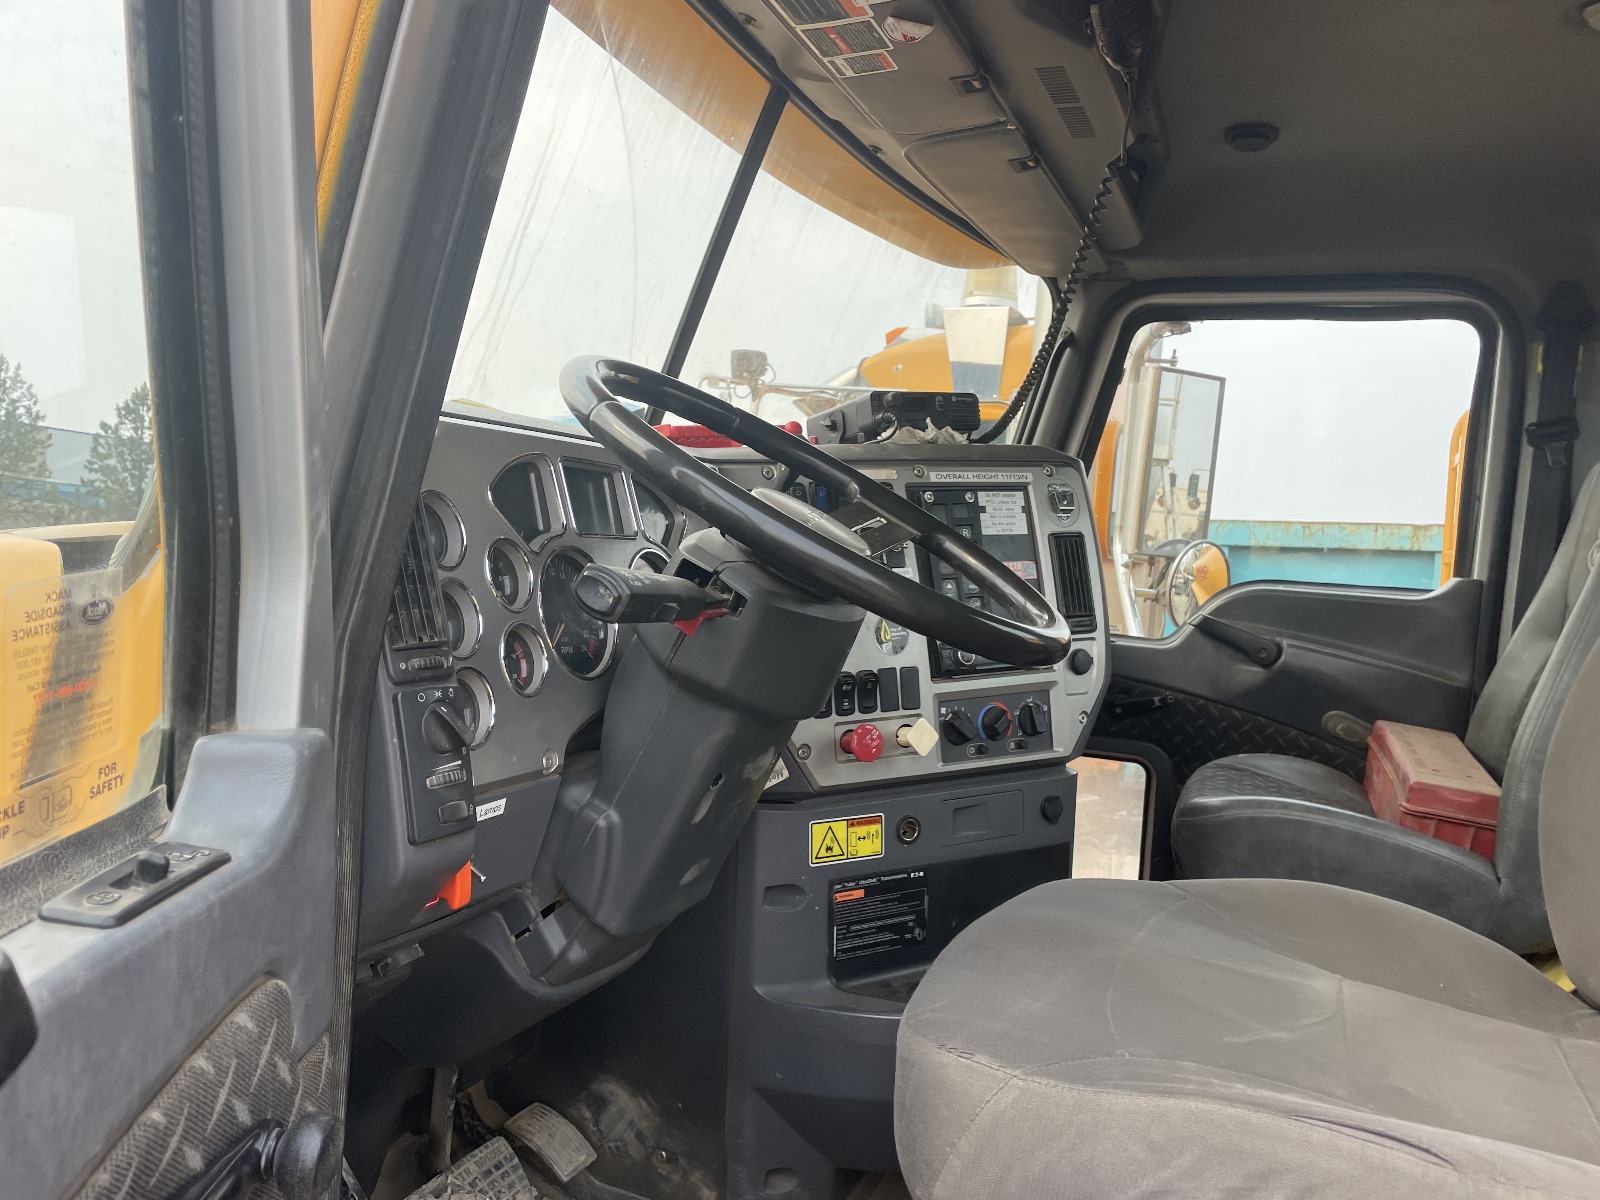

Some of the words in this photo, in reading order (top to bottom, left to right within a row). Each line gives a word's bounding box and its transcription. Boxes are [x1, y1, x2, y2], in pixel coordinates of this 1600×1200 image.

[962, 529, 969, 537] R
[561, 645, 574, 654] RPM
[98, 761, 118, 780] FOR
[89, 772, 125, 800] SAFETY
[0, 800, 24, 821] KLE
[479, 804, 502, 818] Lamps
[856, 818, 881, 826] WARNING
